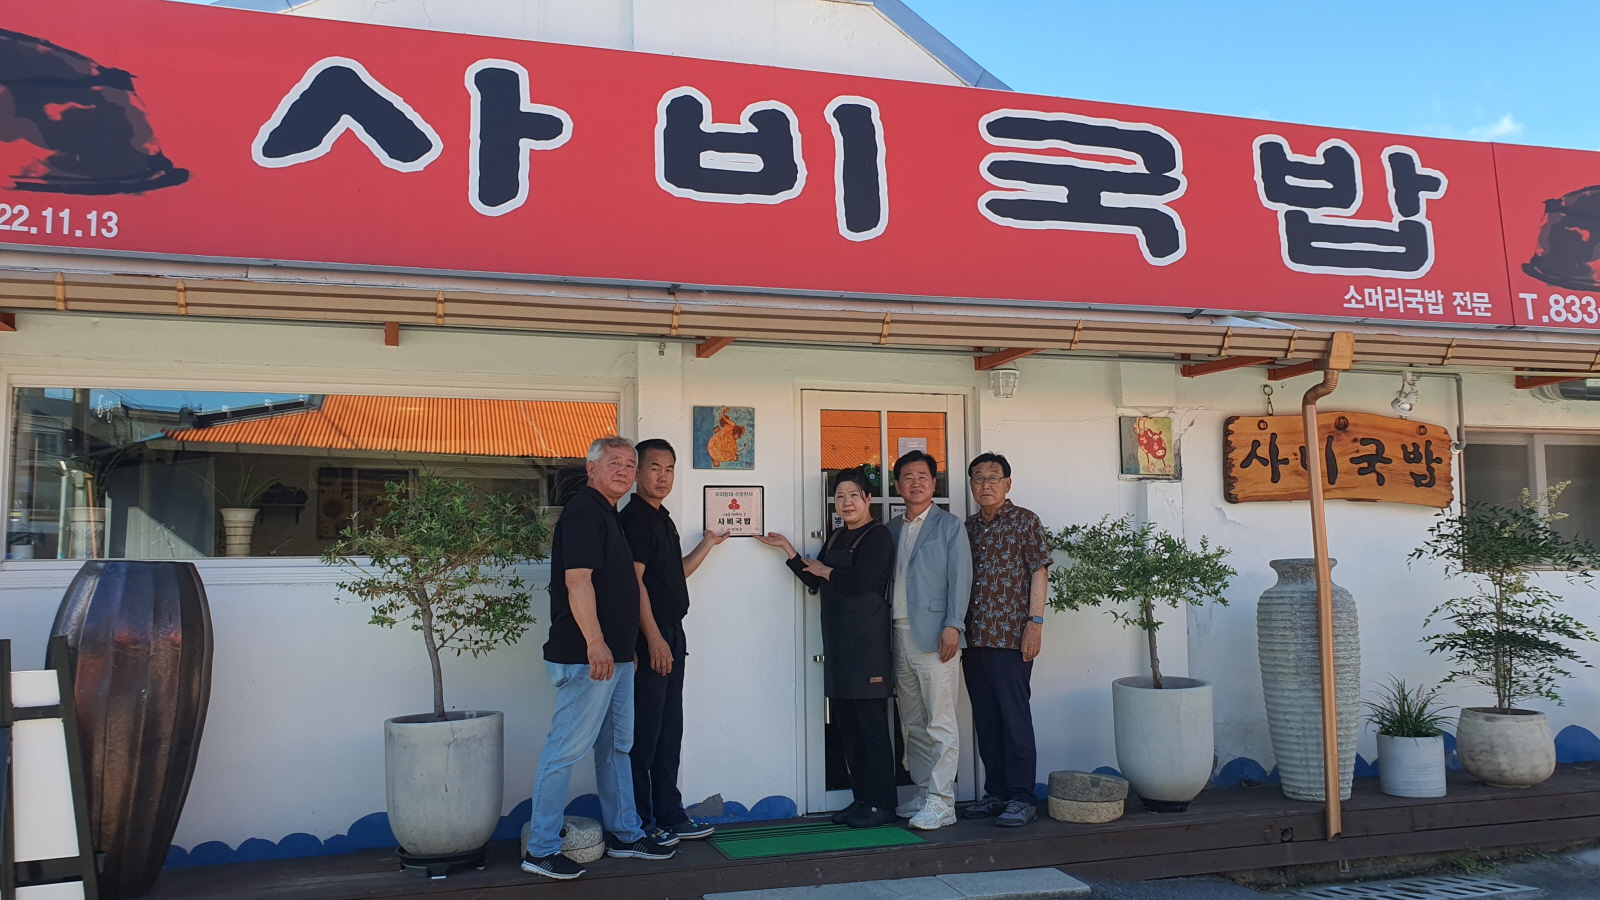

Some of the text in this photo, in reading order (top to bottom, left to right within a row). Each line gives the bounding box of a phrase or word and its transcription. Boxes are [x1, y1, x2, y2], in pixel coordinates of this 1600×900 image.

[251, 55, 1448, 280] 사비국밥
[0, 203, 119, 238] 22.11.13
[1343, 285, 1492, 317] 소머리국밥 전문
[717, 517, 751, 525] 사비국밥
